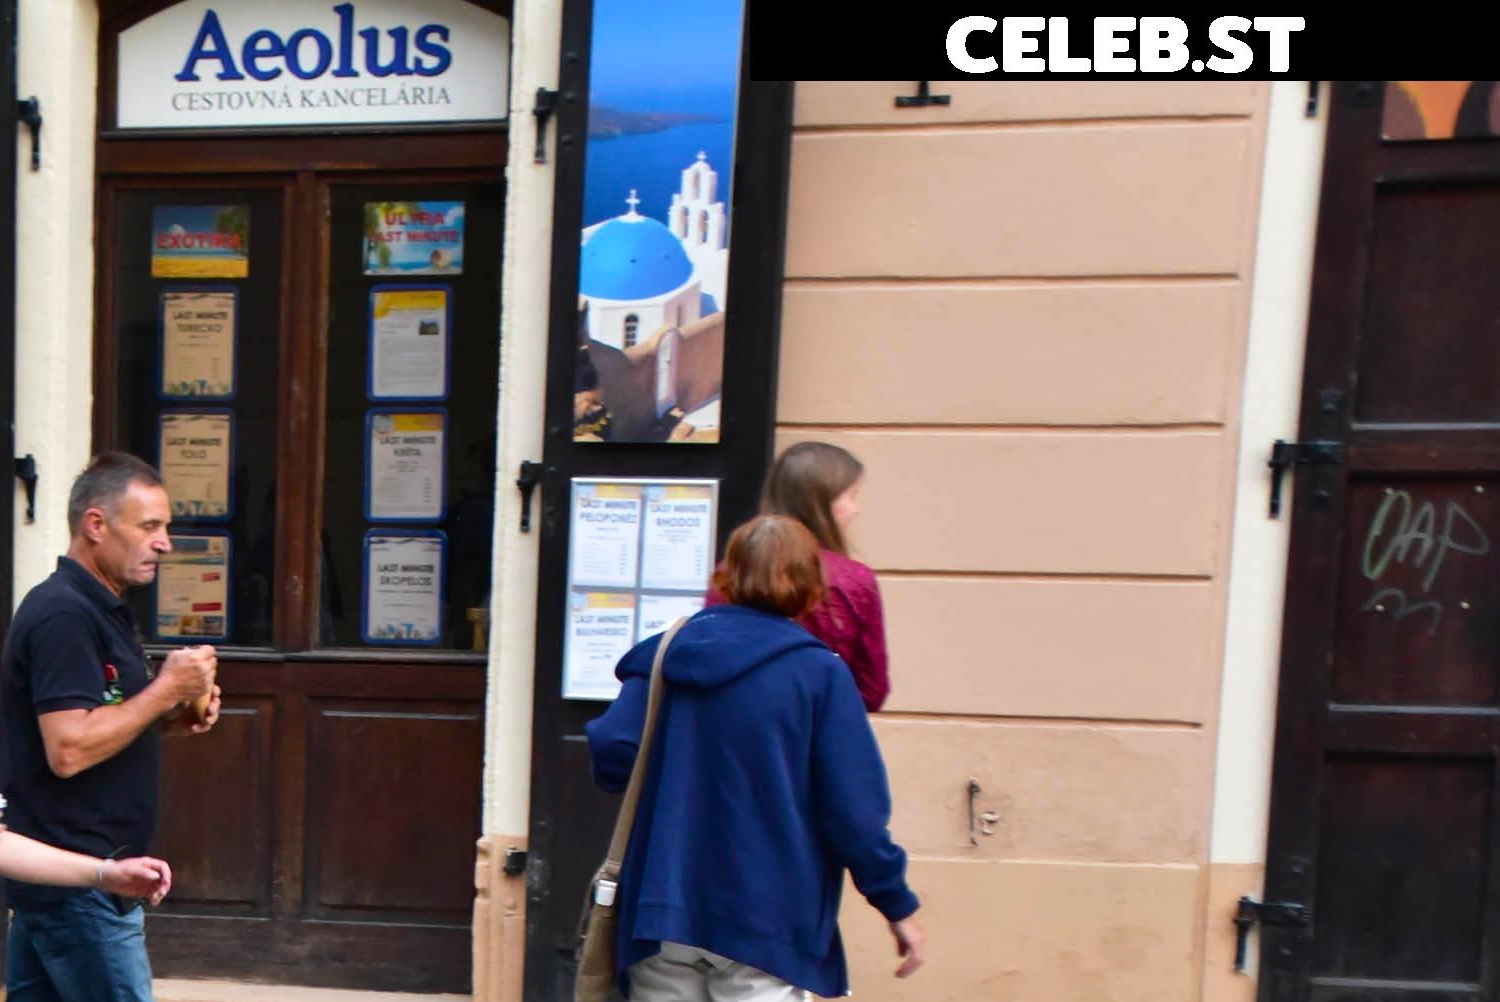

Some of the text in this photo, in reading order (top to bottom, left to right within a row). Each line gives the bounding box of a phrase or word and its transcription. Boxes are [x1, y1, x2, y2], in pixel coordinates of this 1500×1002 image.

[174, 3, 452, 81] Aeolus
[171, 85, 452, 111] CESTOVNÁ KANCELÁRIA
